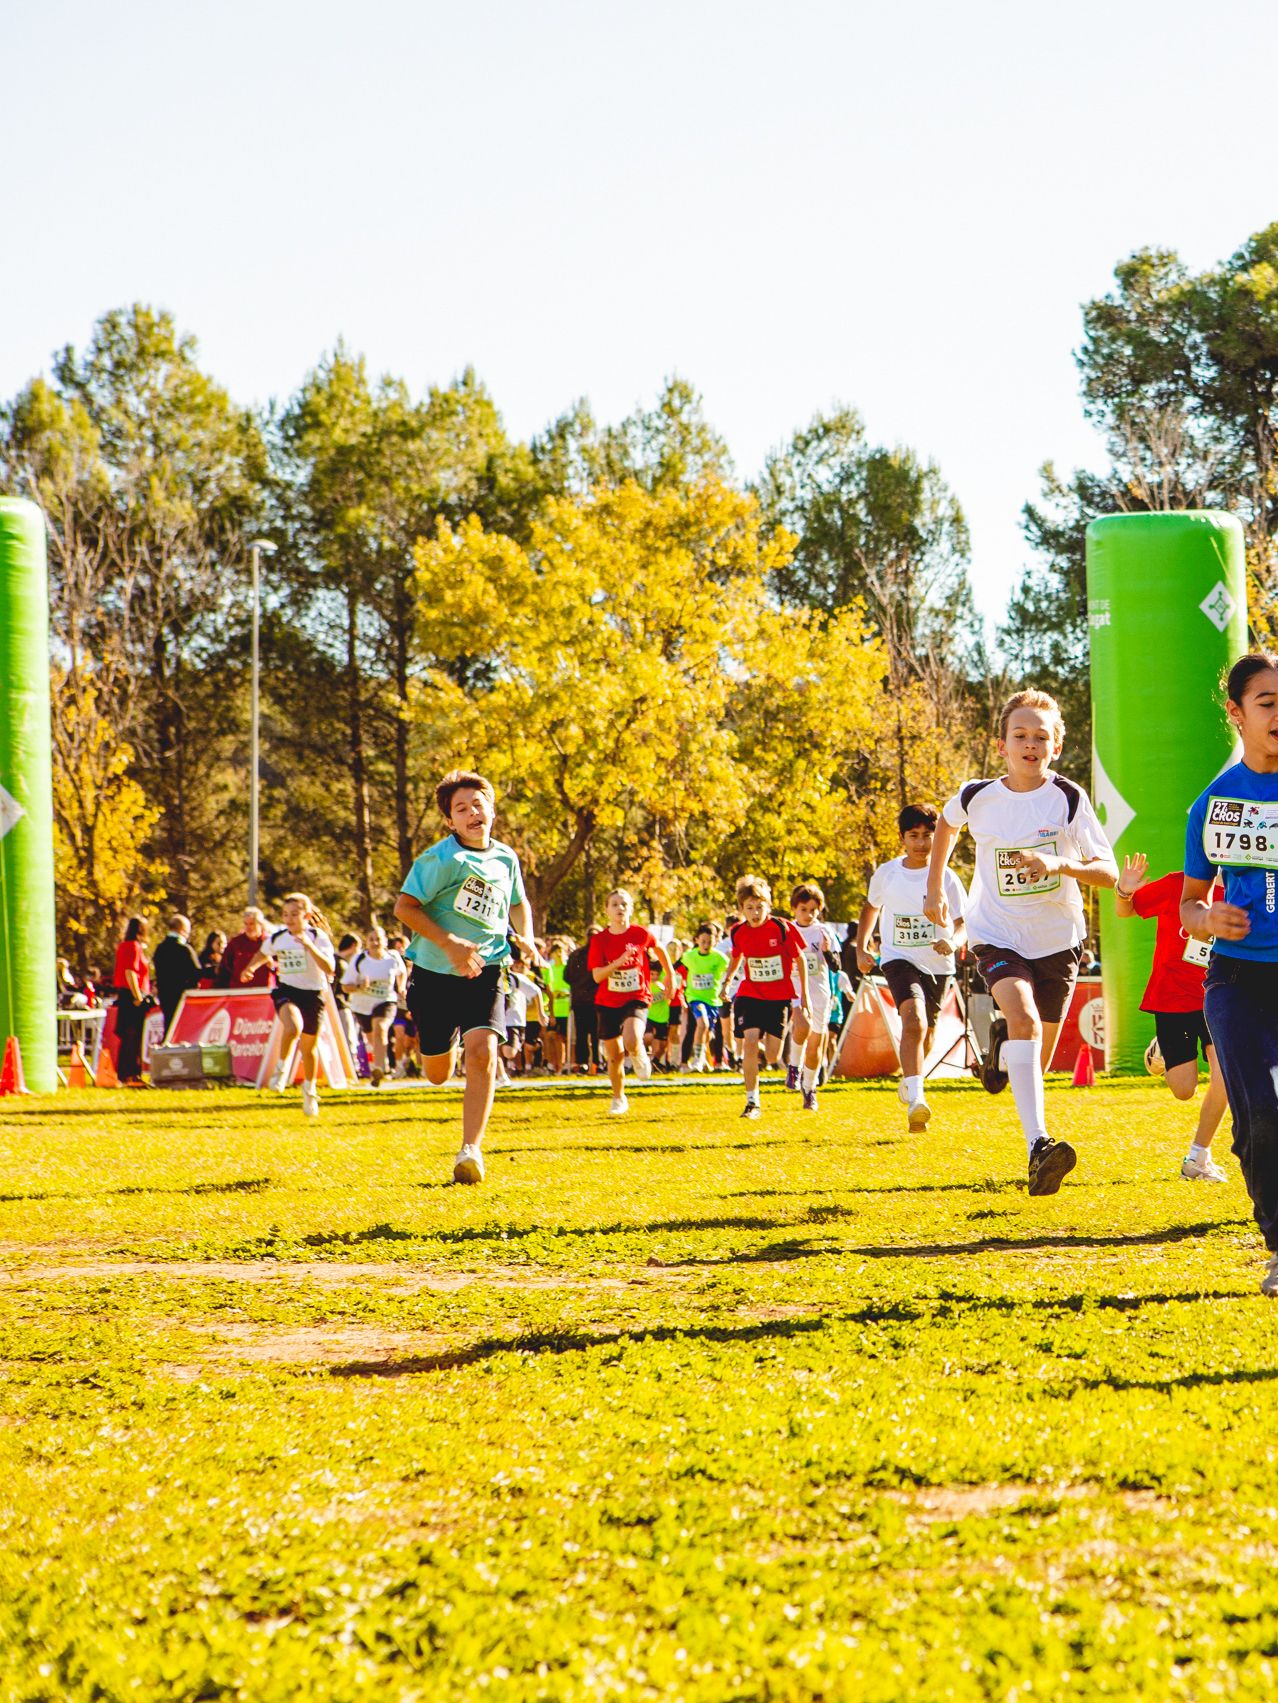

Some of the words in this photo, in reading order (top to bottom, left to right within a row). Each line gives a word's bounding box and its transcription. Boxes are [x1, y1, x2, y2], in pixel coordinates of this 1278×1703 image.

[1212, 811, 1240, 822] CROS
[1215, 832, 1267, 851] 1798
[1266, 872, 1276, 913] GERBERT
[466, 897, 491, 916] 1211
[900, 931, 928, 940] 3184
